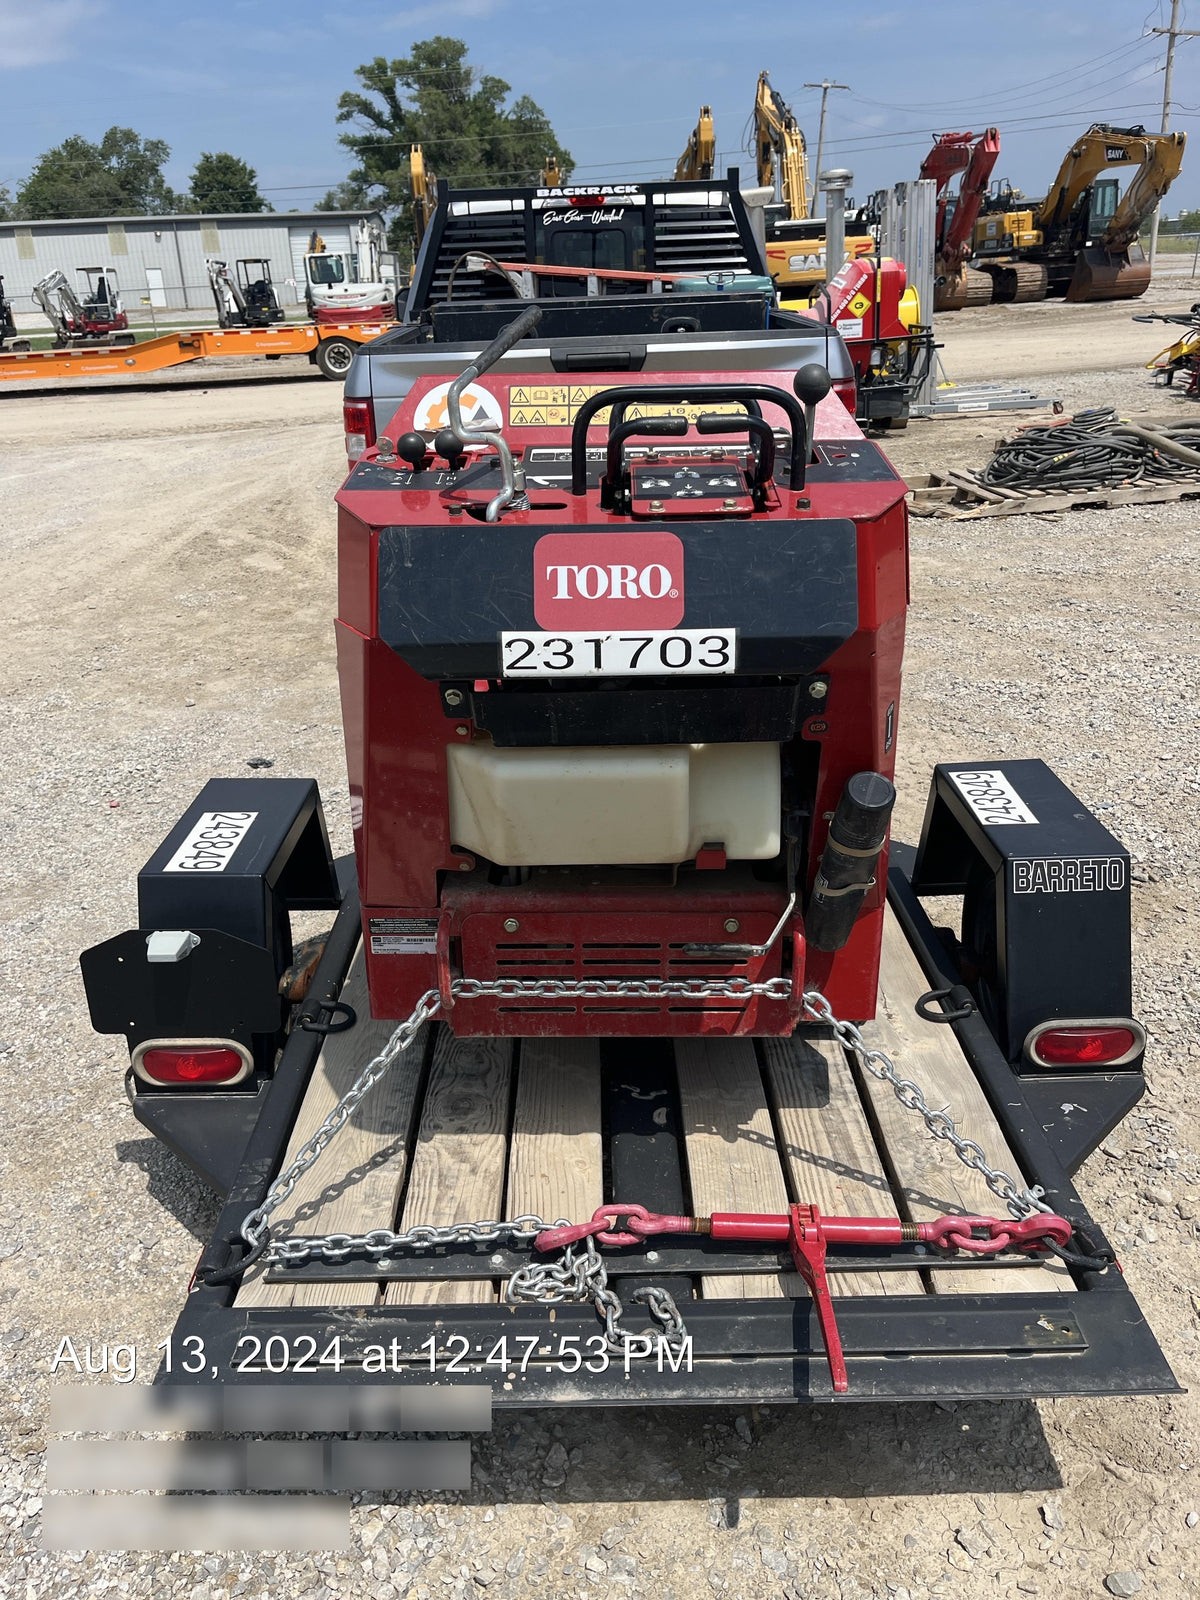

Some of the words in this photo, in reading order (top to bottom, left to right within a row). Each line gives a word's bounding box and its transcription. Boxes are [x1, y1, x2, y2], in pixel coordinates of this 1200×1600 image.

[1107, 149, 1124, 159] SANY
[536, 185, 639, 197] BACKRACK
[789, 252, 850, 271] SA
[504, 635, 730, 670] 231703
[954, 772, 1027, 824] 243849
[178, 812, 252, 870] 243849
[1013, 858, 1125, 894] BARRETO
